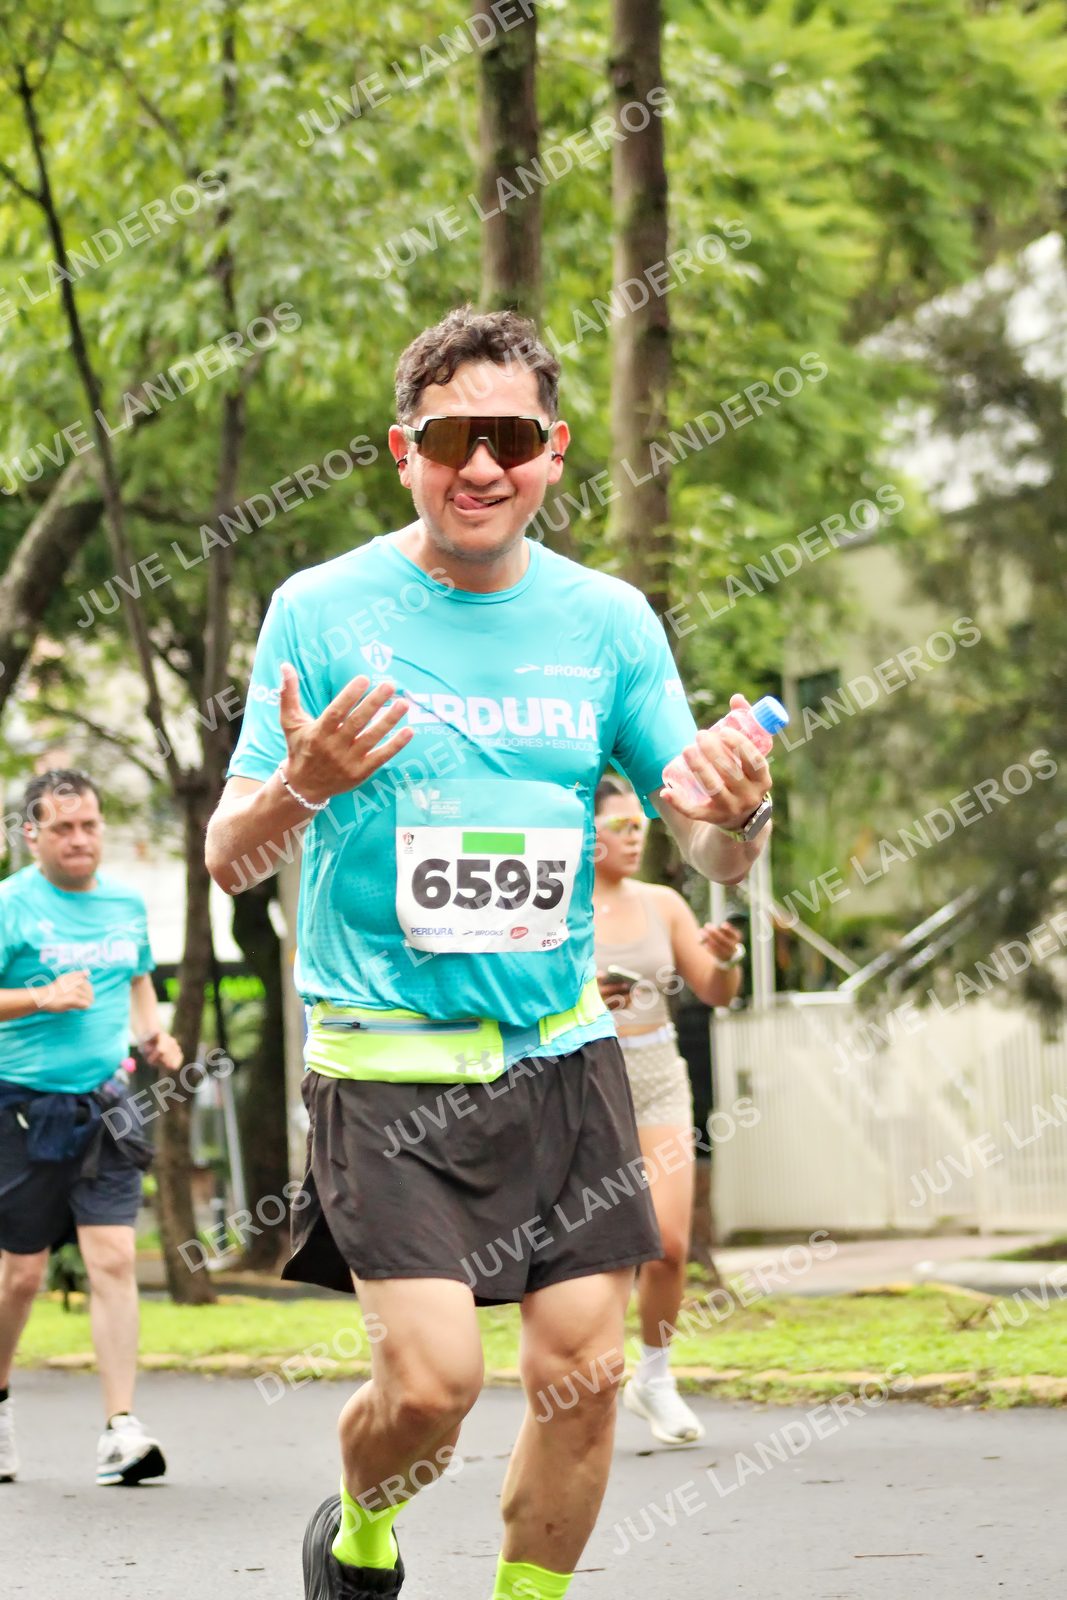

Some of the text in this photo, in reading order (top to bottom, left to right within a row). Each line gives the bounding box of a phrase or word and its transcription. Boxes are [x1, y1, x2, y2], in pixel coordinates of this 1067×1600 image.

[544, 665, 602, 679] BROOKS
[376, 693, 598, 741] ERDURA
[411, 858, 566, 910] 6595
[411, 928, 453, 936] PERDURA
